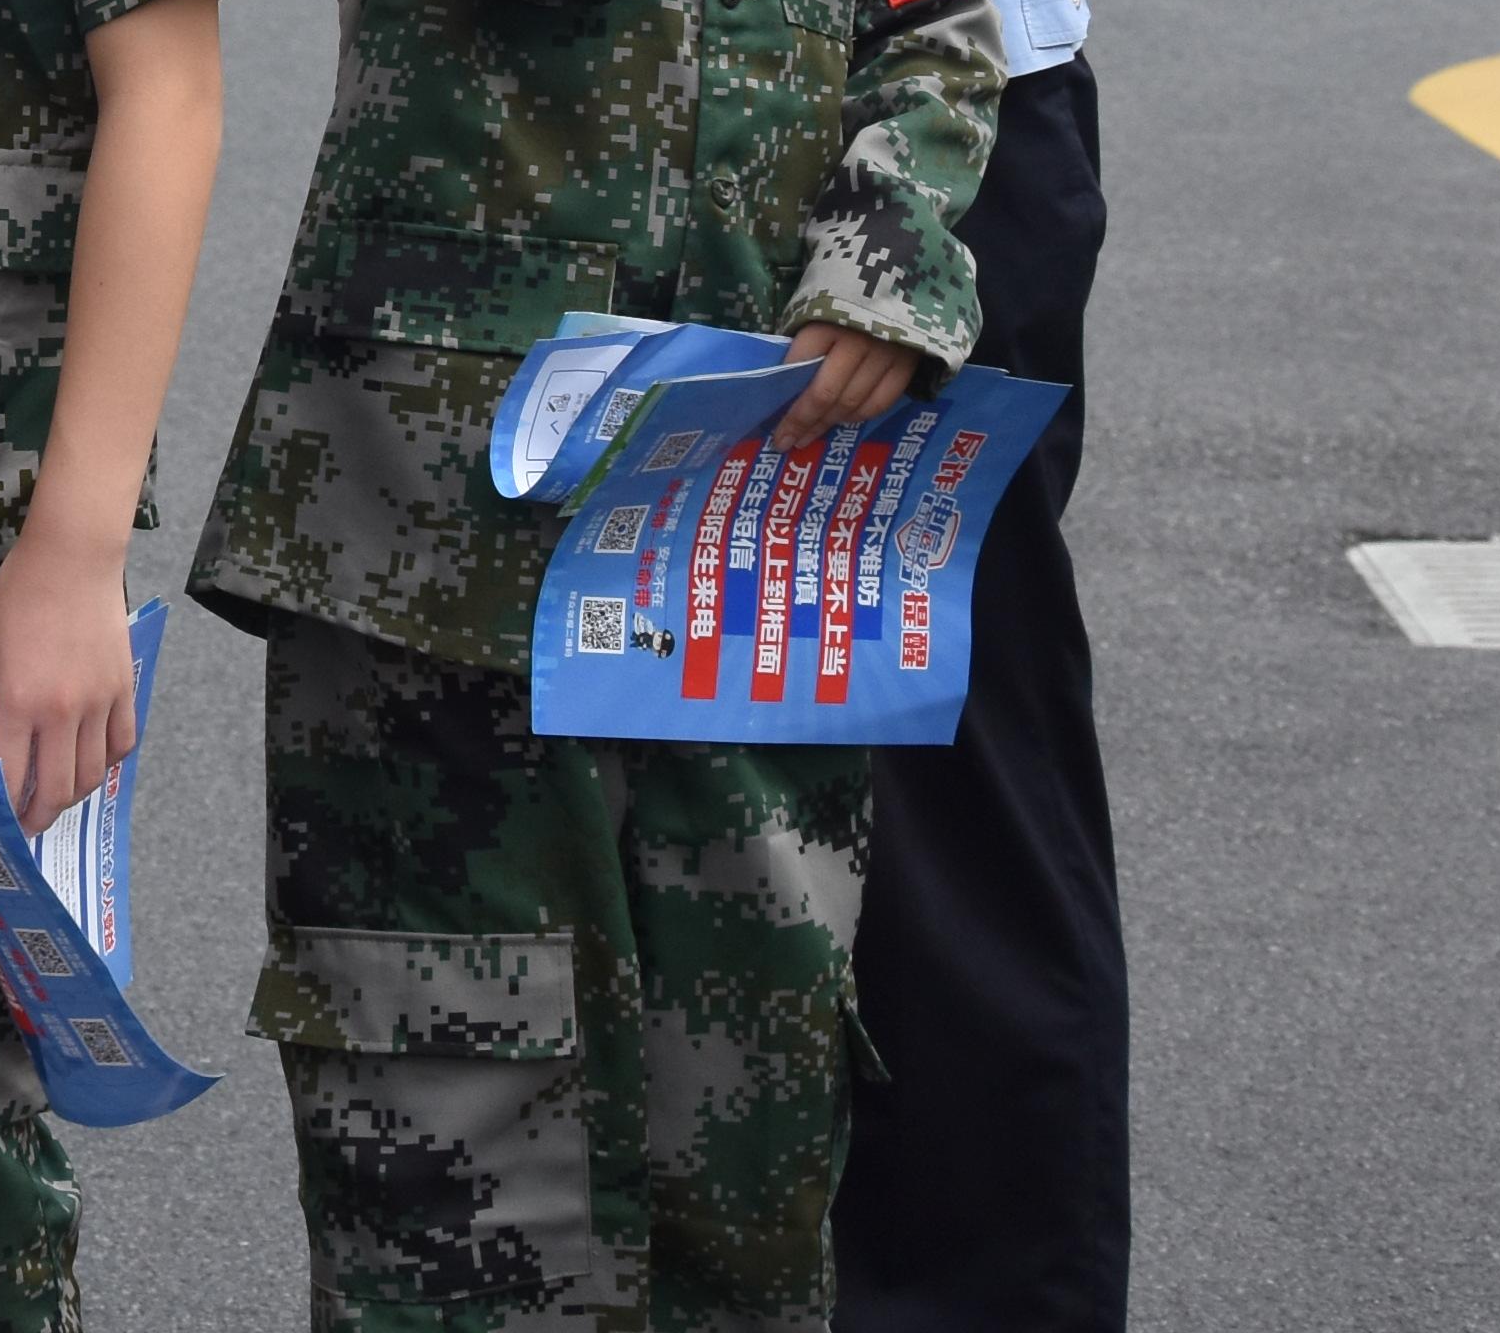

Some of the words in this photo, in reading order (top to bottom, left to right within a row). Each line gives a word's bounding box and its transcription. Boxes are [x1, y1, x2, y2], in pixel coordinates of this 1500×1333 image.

[690, 458, 747, 641] 拒接陌生来电
[856, 410, 939, 608] 电信诈骗不难防
[932, 429, 988, 494] 反诈
[756, 462, 812, 676] 万元以上到柜面
[821, 465, 877, 676] 不给不要不上当
